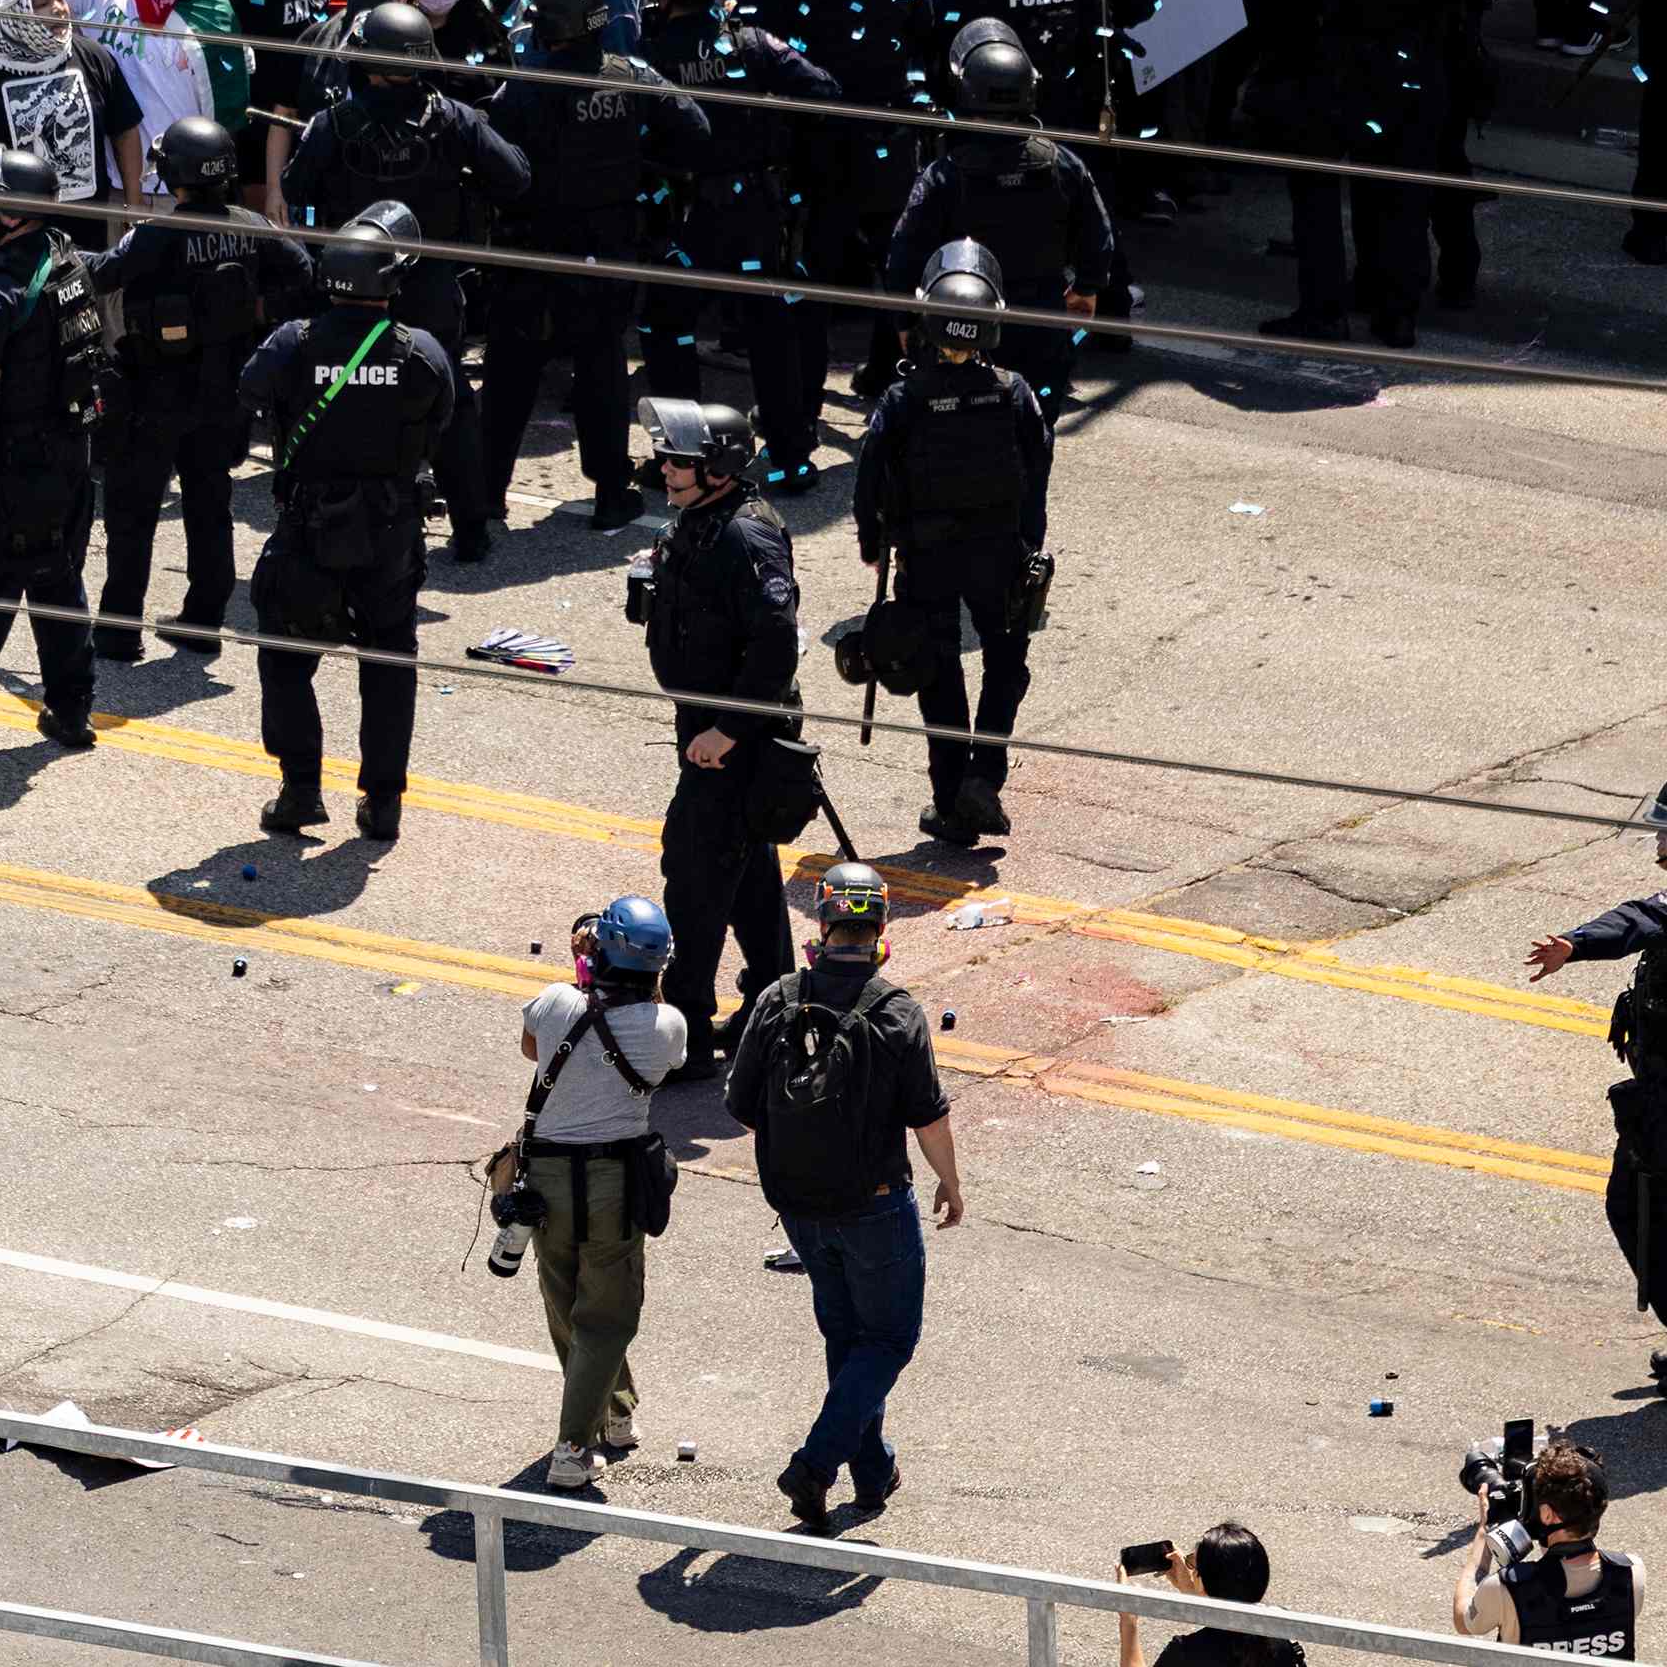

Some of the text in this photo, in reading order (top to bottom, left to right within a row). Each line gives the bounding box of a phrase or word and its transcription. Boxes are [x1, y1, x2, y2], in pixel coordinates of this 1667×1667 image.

[678, 57, 727, 86] MURO
[575, 95, 628, 122] SOSA
[57, 279, 85, 306] POLICE
[314, 364, 399, 386] POLICE
[1570, 1603, 1596, 1613] POWELL
